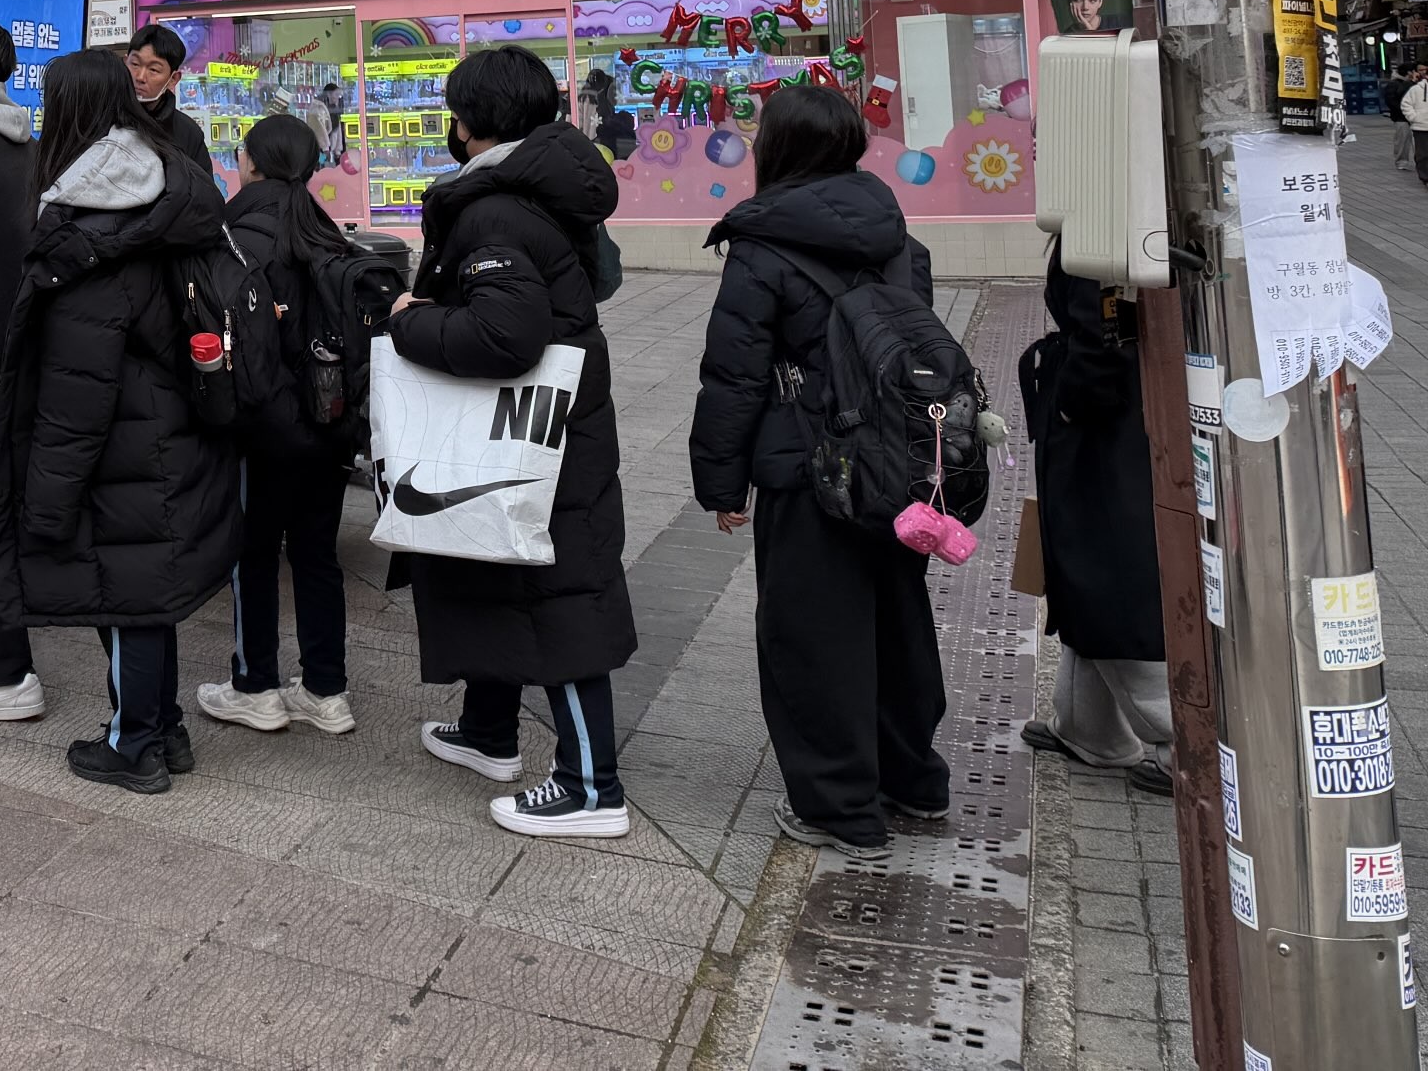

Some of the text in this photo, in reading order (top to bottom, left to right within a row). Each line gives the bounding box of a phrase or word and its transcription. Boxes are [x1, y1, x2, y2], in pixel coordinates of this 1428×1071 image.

[11, 21, 60, 50] 멈춤 없는
[13, 64, 27, 90] 길
[1281, 173, 1330, 192] 보증금
[1300, 203, 1331, 222] 월세
[1277, 262, 1319, 276] 구월동
[1267, 285, 1281, 299] 방
[1354, 855, 1394, 879] 카드
[1353, 879, 1384, 893] 단말기등록
